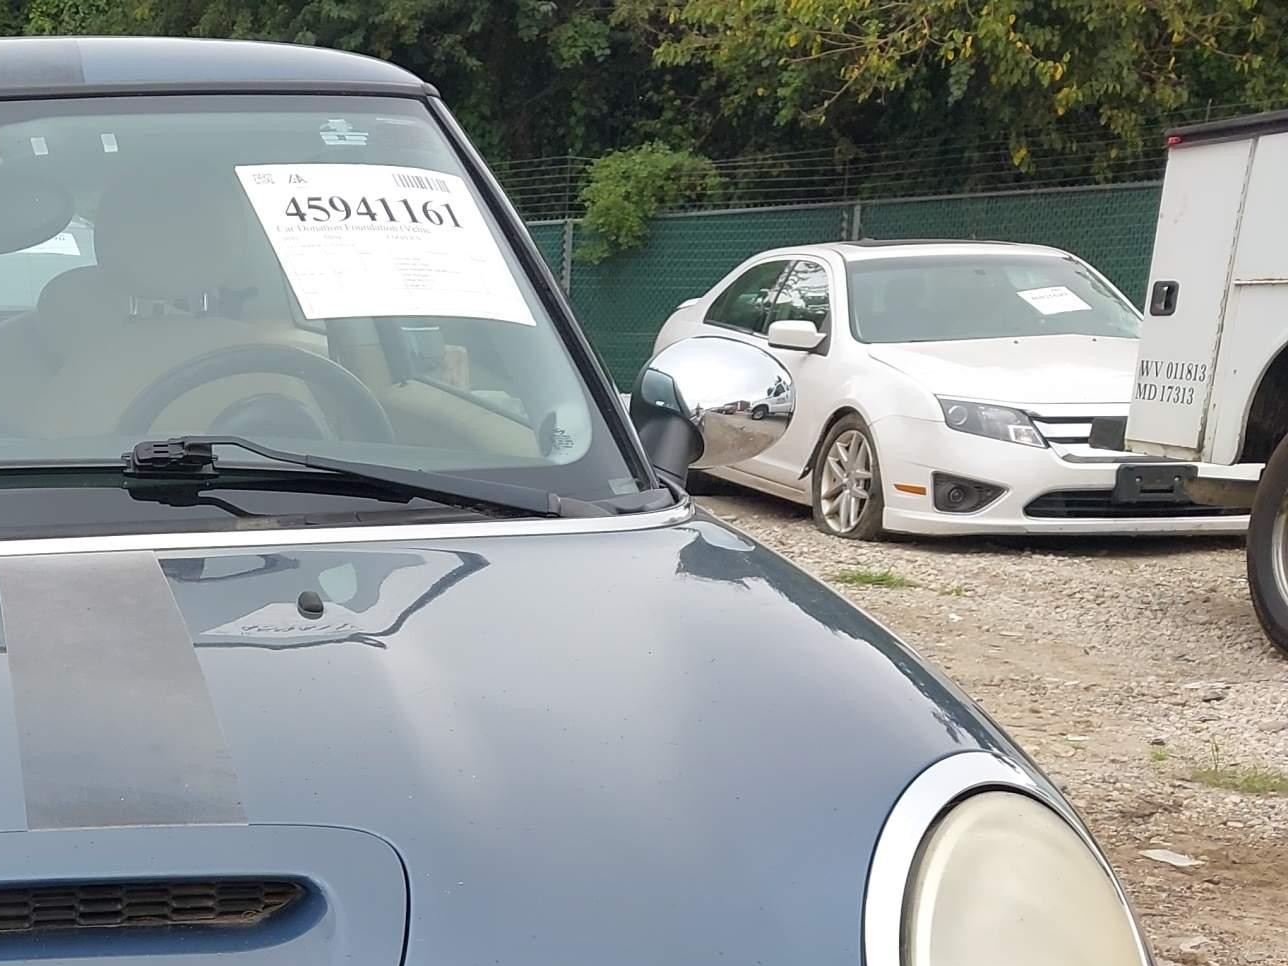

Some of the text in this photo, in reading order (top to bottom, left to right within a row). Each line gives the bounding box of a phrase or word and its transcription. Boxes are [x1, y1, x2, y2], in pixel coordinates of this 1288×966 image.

[285, 196, 464, 229] 45941161
[1140, 360, 1208, 382] WV 011813
[1135, 382, 1195, 406] MD 17313
